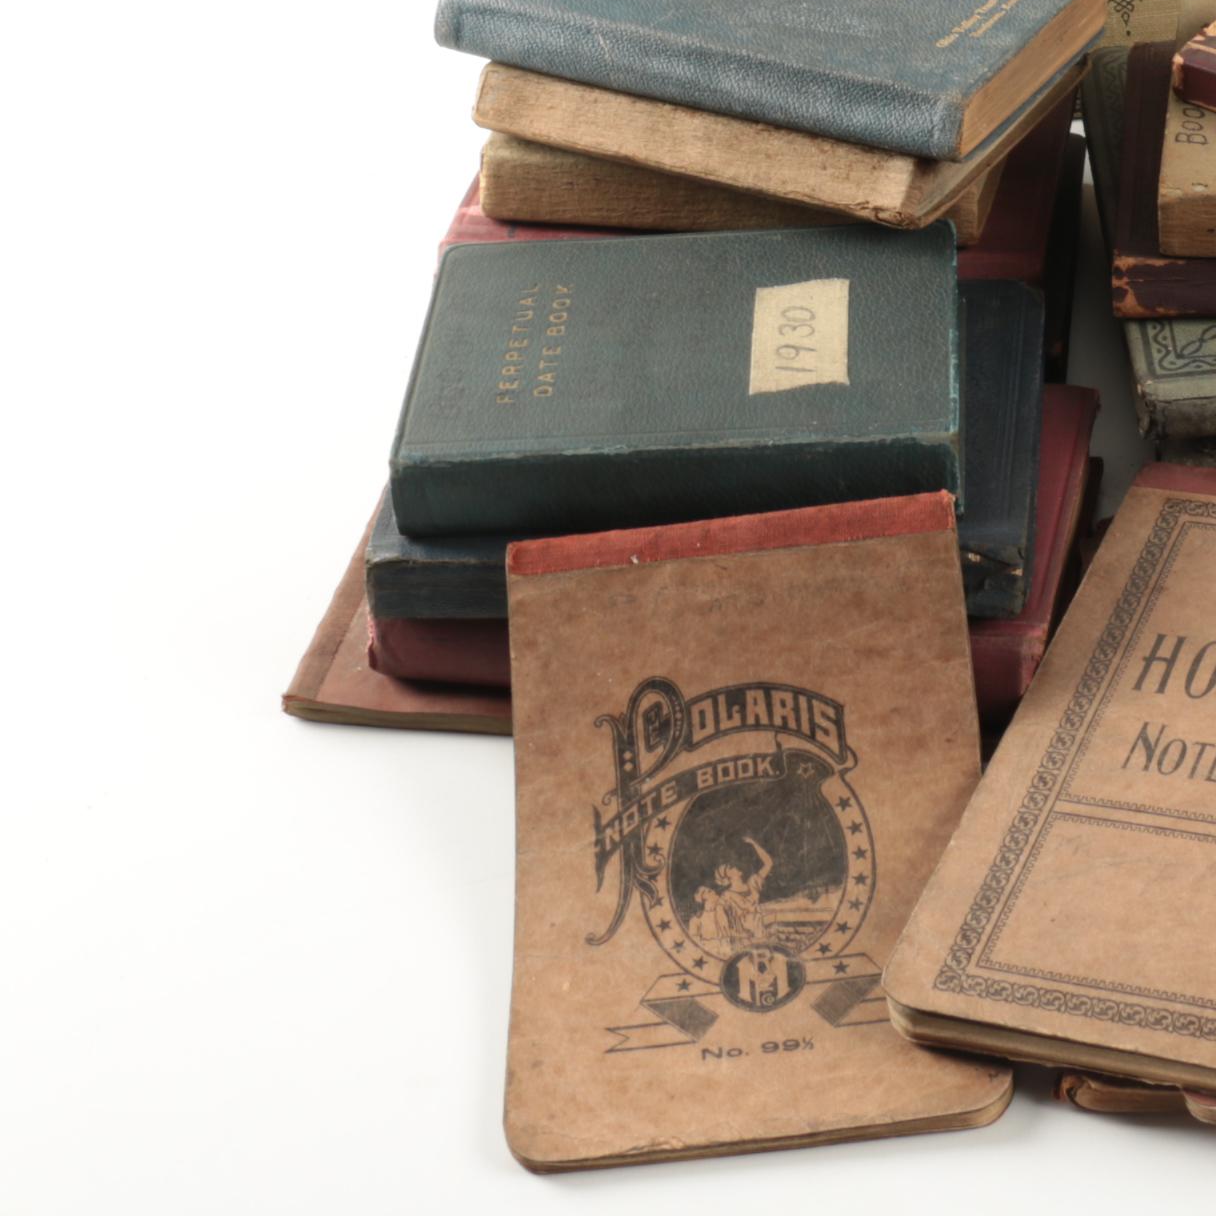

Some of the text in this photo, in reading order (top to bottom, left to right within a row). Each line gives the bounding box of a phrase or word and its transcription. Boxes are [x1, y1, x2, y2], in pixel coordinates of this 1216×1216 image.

[496, 282, 539, 403] PERPETUAL
[533, 284, 574, 397] DATE BOOK
[775, 305, 816, 372] 1930
[603, 756, 781, 852] NOTE BOOK.
[702, 1047, 749, 1061] No.
